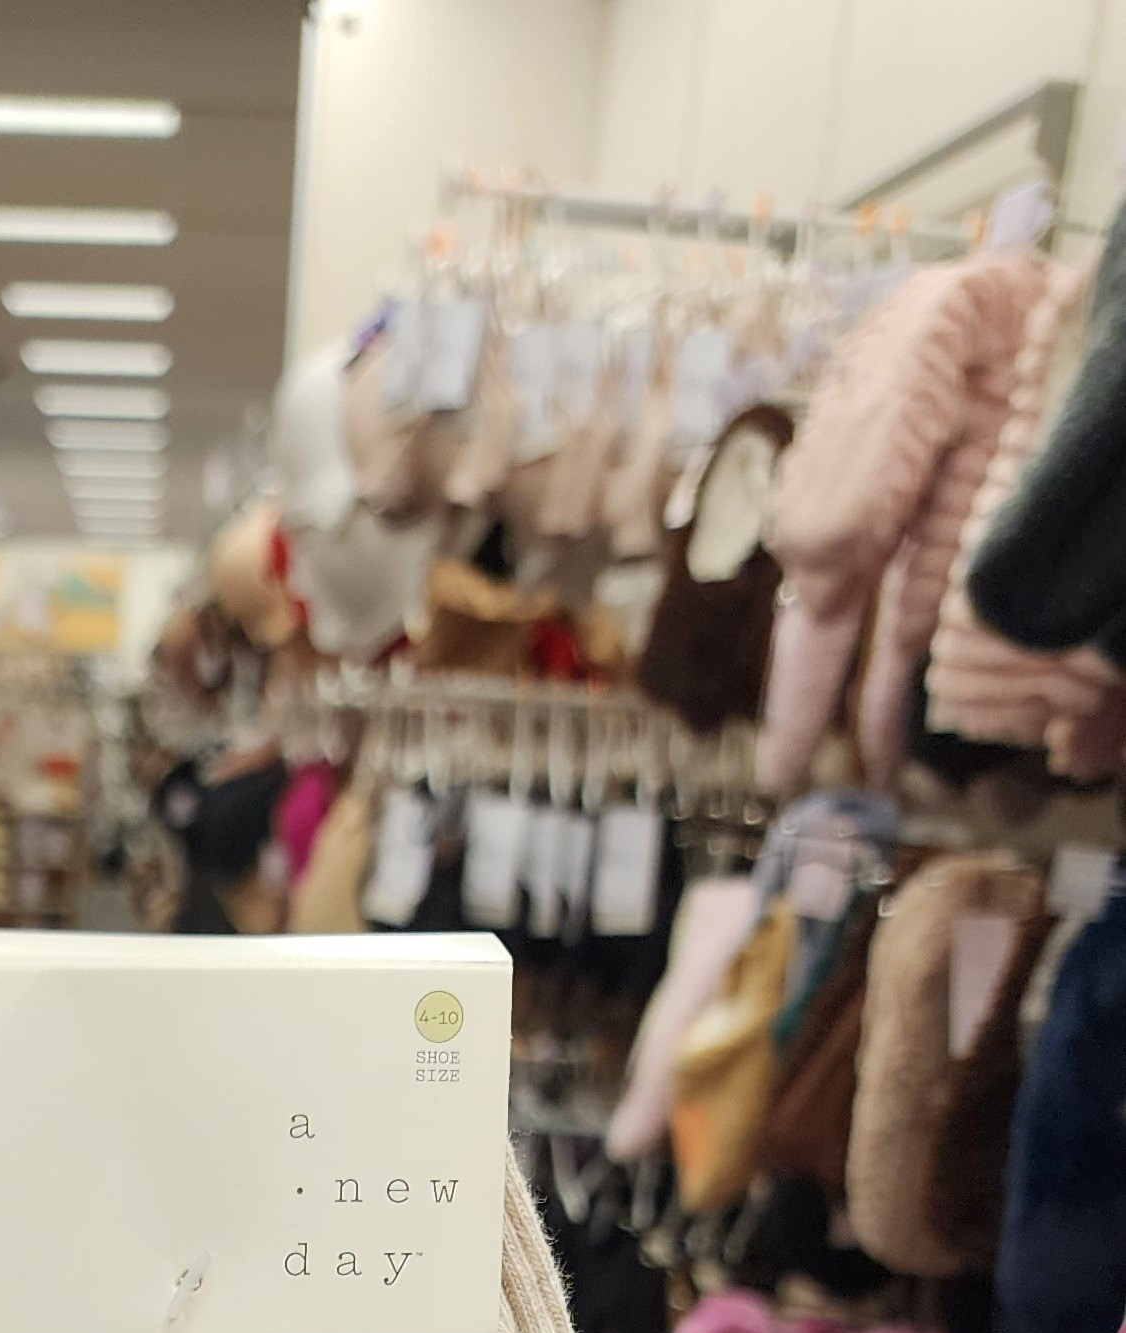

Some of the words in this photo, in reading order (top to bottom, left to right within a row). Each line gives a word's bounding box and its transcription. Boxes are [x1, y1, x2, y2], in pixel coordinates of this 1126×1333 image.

[419, 1010, 459, 1025] 4-10
[415, 1050, 461, 1065] SHOE
[415, 1068, 460, 1083] SIZE
[289, 1113, 315, 1139] a
